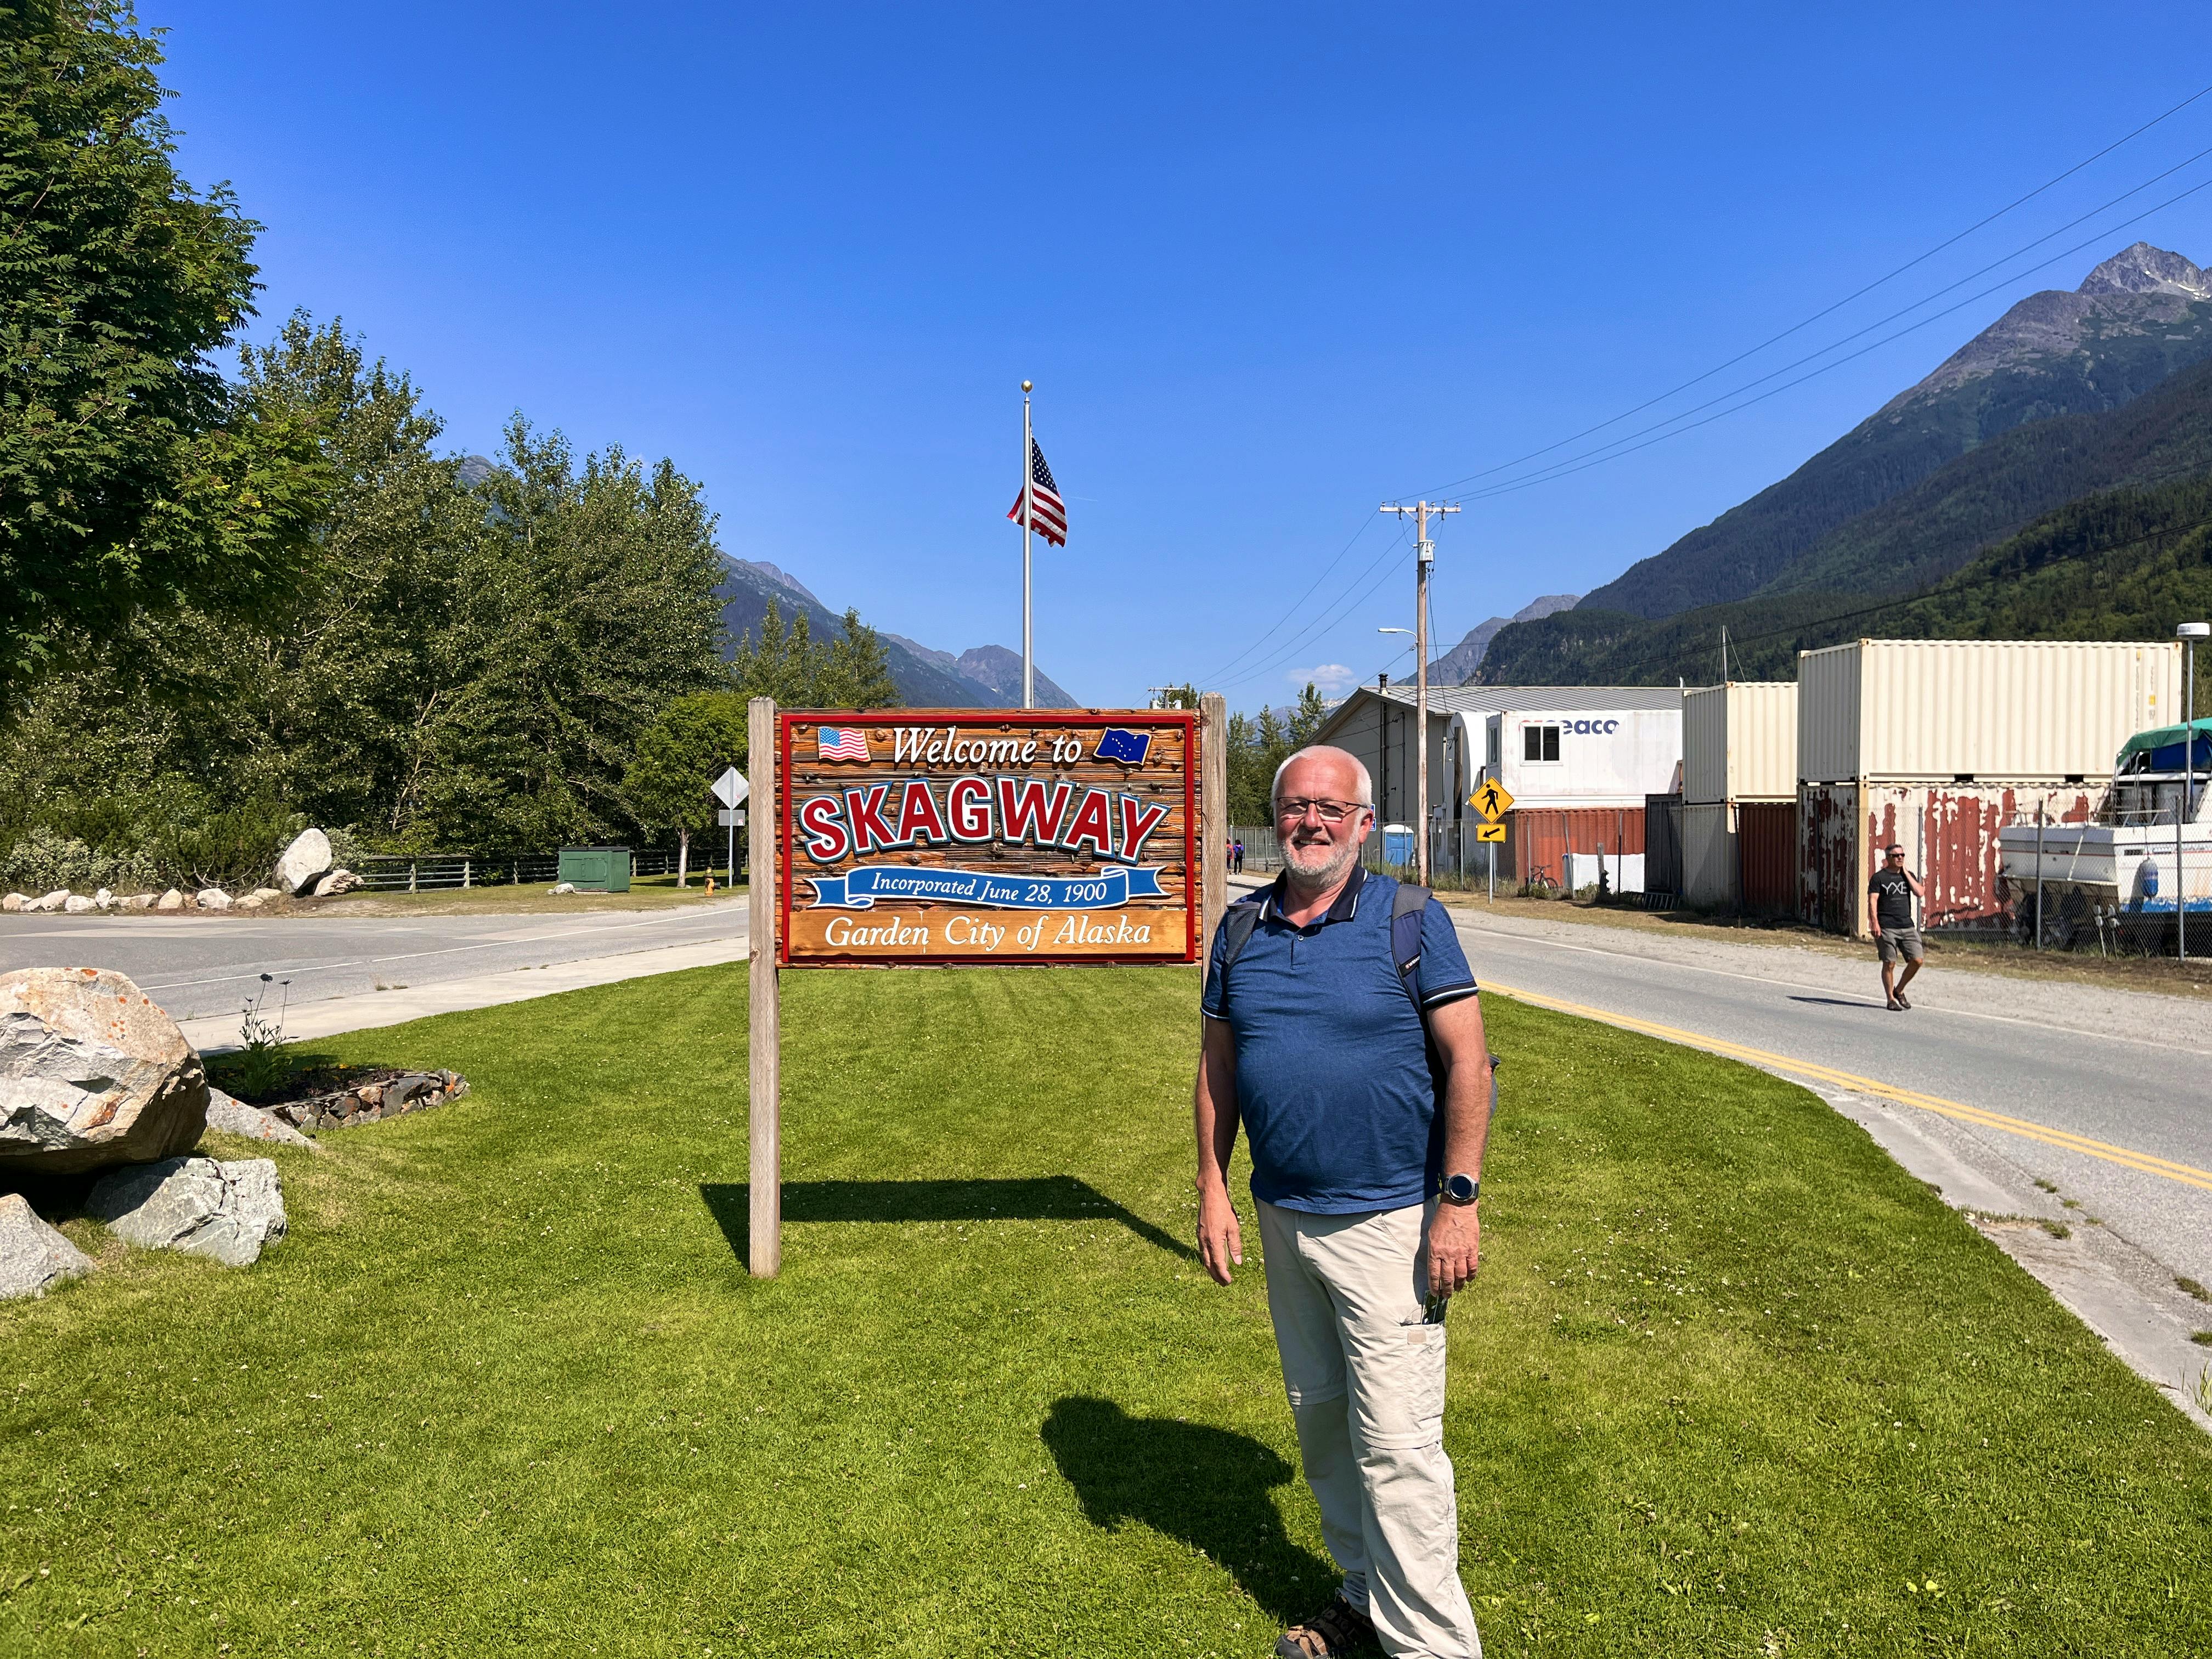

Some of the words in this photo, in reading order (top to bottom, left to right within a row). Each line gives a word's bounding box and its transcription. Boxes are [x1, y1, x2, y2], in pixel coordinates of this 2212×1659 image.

[893, 725, 1037, 763] Welcome
[1052, 735, 1082, 763] to
[799, 775, 1172, 865] SKAGWAY
[871, 872, 977, 896] Incorporated
[977, 881, 1019, 901] June
[1024, 884, 1053, 905] 28,
[1063, 882, 1108, 903] 1900
[1881, 881, 1908, 895] YXE
[825, 916, 930, 946] Garden
[945, 916, 1006, 952] City
[1016, 914, 1049, 951] of
[1052, 915, 1151, 944] Alaska
